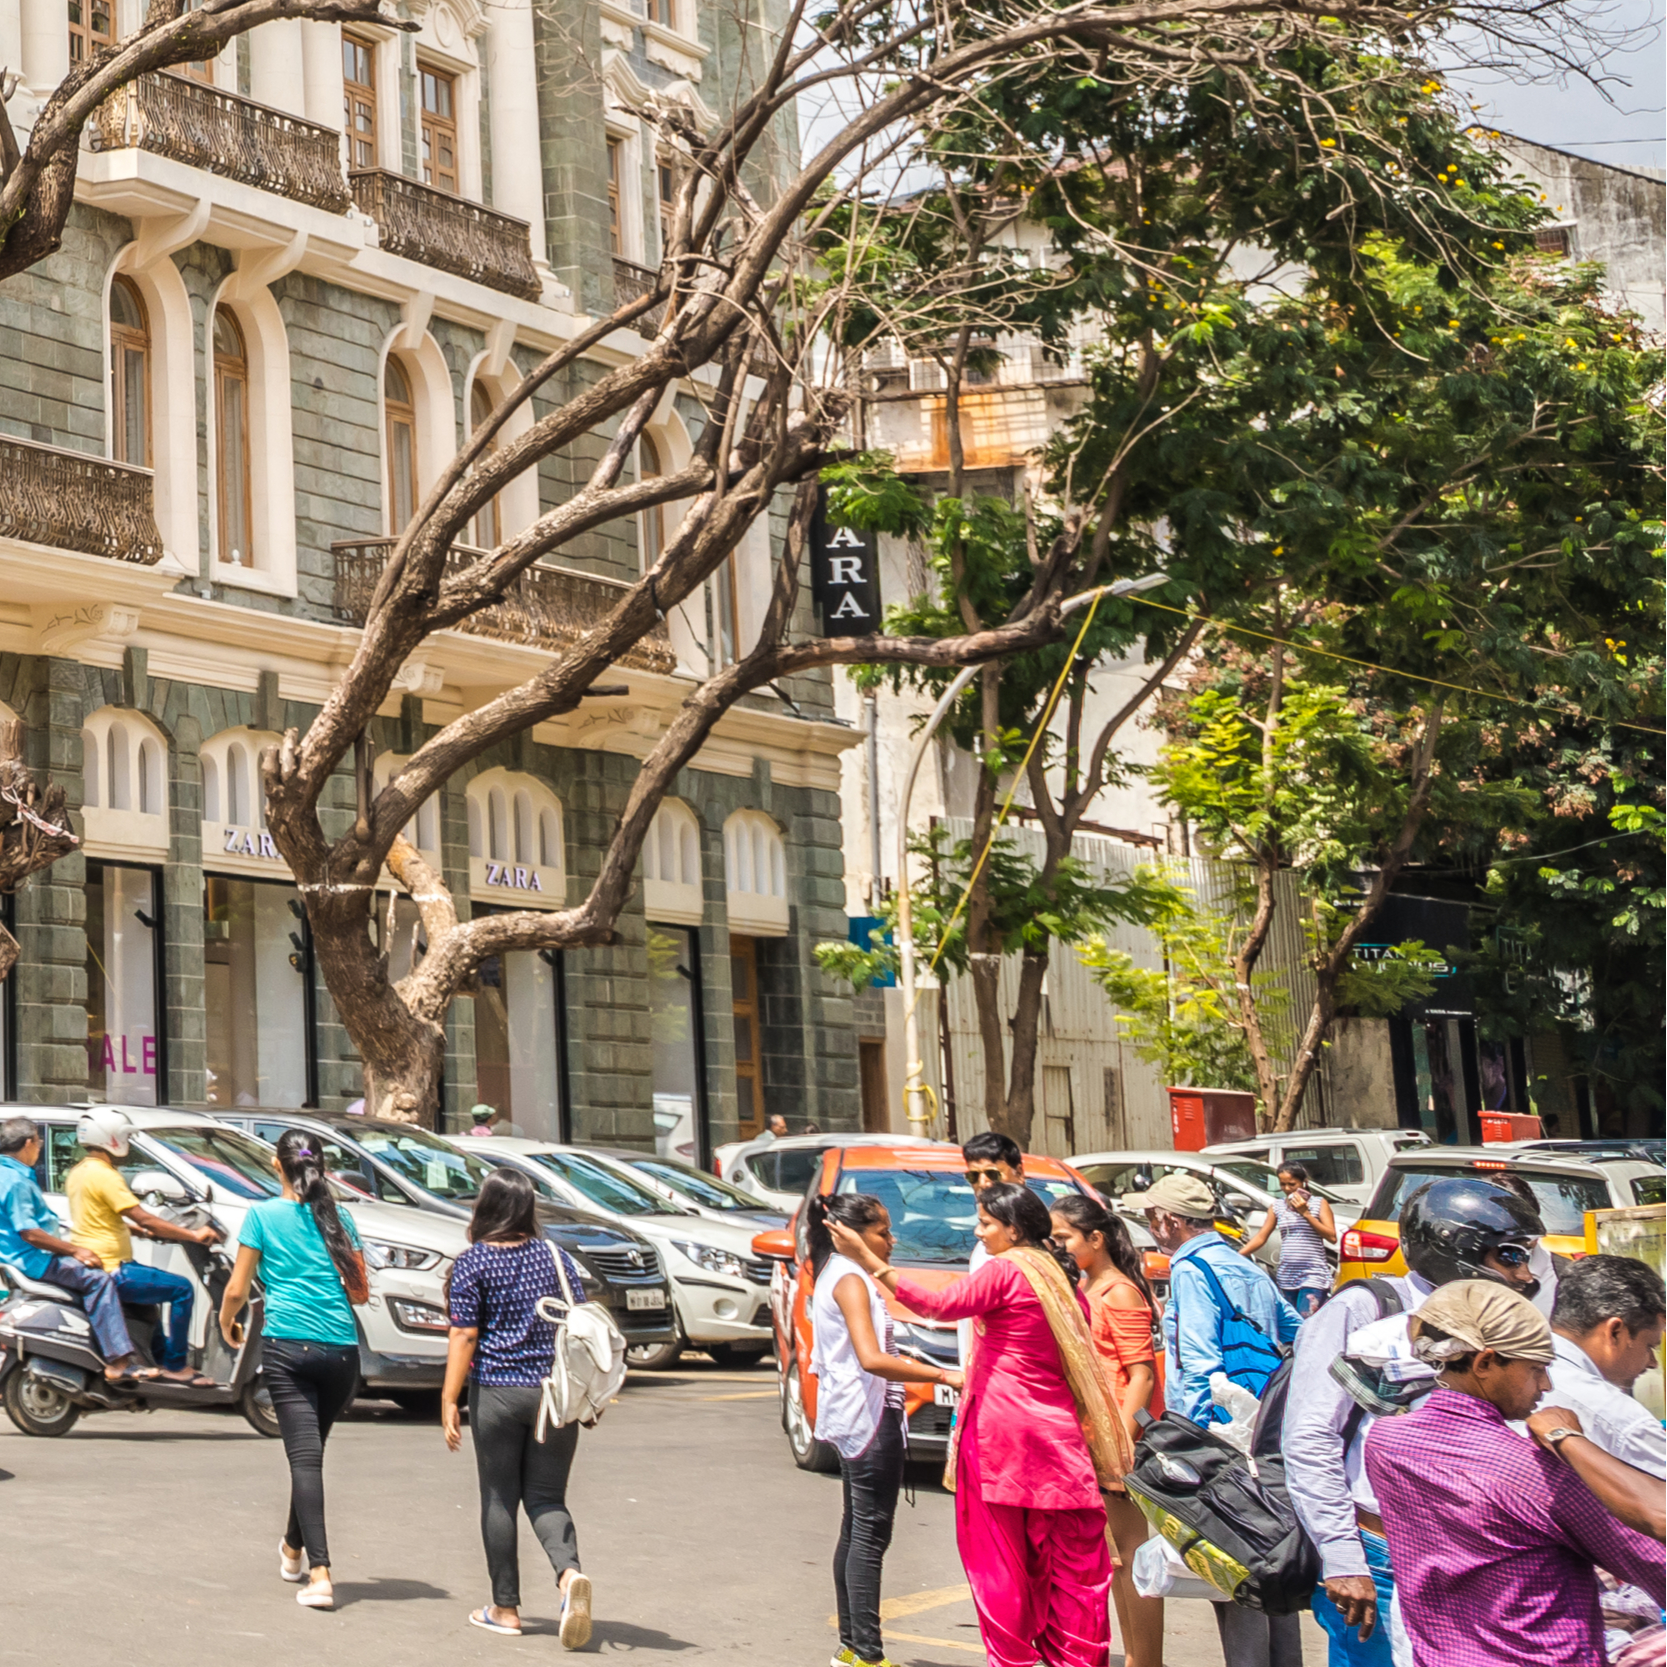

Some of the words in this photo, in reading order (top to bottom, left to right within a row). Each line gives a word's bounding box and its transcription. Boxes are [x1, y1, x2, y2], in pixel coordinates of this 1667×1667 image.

[825, 526, 870, 619] ARA
[224, 828, 283, 859] ZAR
[486, 863, 543, 892] ZARA
[87, 1033, 156, 1074] ALE
